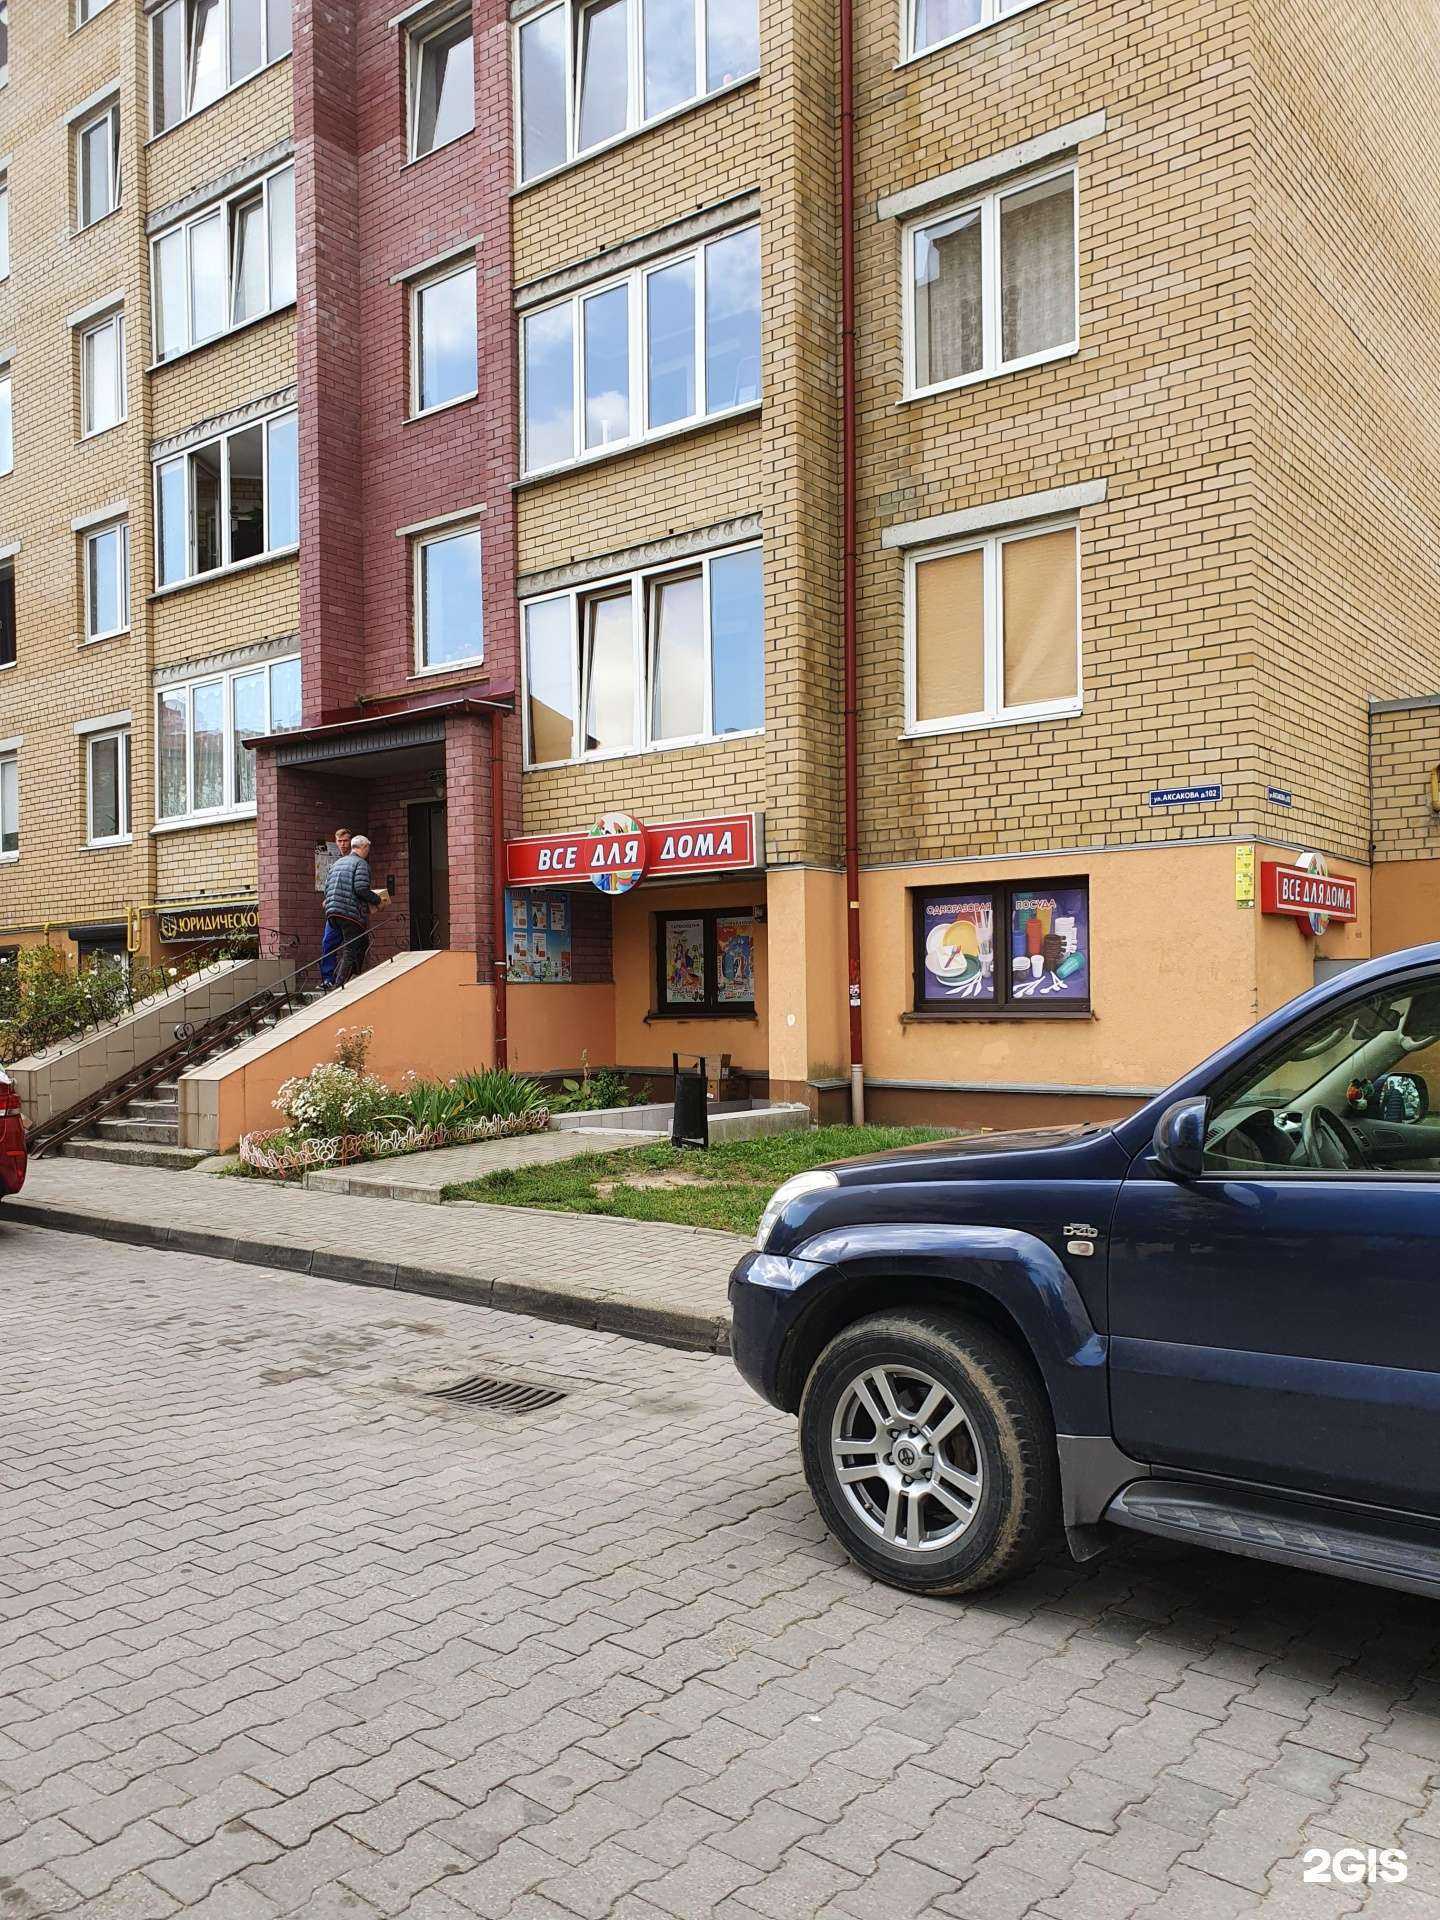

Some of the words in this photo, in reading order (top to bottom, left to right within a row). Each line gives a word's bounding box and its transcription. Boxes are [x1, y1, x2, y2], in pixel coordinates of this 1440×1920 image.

[1162, 791, 1200, 801] АКСАКОВА
[537, 846, 578, 871] ВСЕ
[590, 840, 639, 867] ДЛЯ
[660, 831, 733, 860] ДОМА
[1282, 877, 1301, 901] ВСЕ
[1303, 879, 1325, 905] ДЛЯ
[1325, 884, 1352, 911] ДОМА
[926, 902, 992, 916] ОДНОРАЗОВАЯ
[1015, 898, 1057, 911] ПОСУДА
[178, 912, 259, 932] ЮРИДИЧЕСКО
